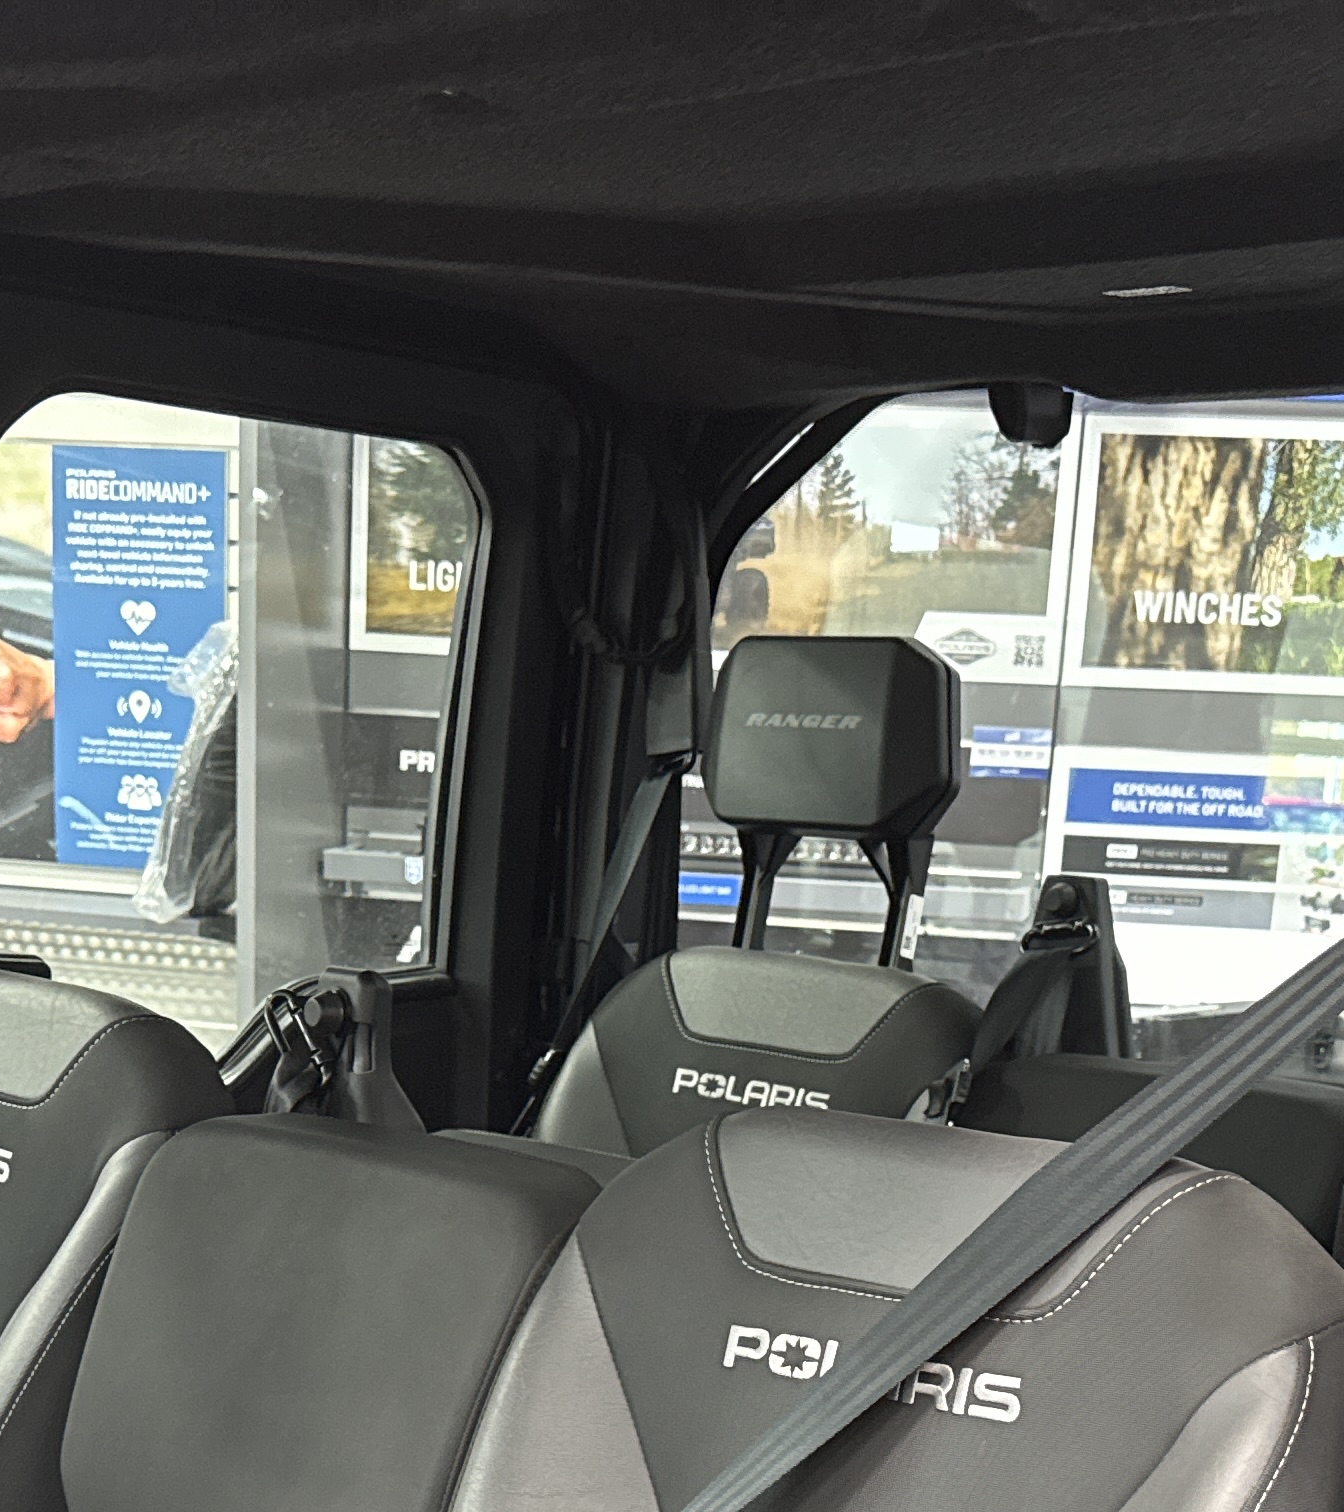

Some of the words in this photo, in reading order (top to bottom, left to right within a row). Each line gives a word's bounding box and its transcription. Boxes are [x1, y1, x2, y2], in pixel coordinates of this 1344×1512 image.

[1133, 589, 1283, 628] WINCHES
[744, 712, 862, 729] RANGER
[1111, 799, 1146, 814] BUILT
[1147, 801, 1175, 815] FOR
[1175, 801, 1201, 817] THE
[1201, 803, 1227, 817] OFF
[671, 1067, 831, 1109] POLARIS
[723, 1324, 1022, 1423] PORIS
